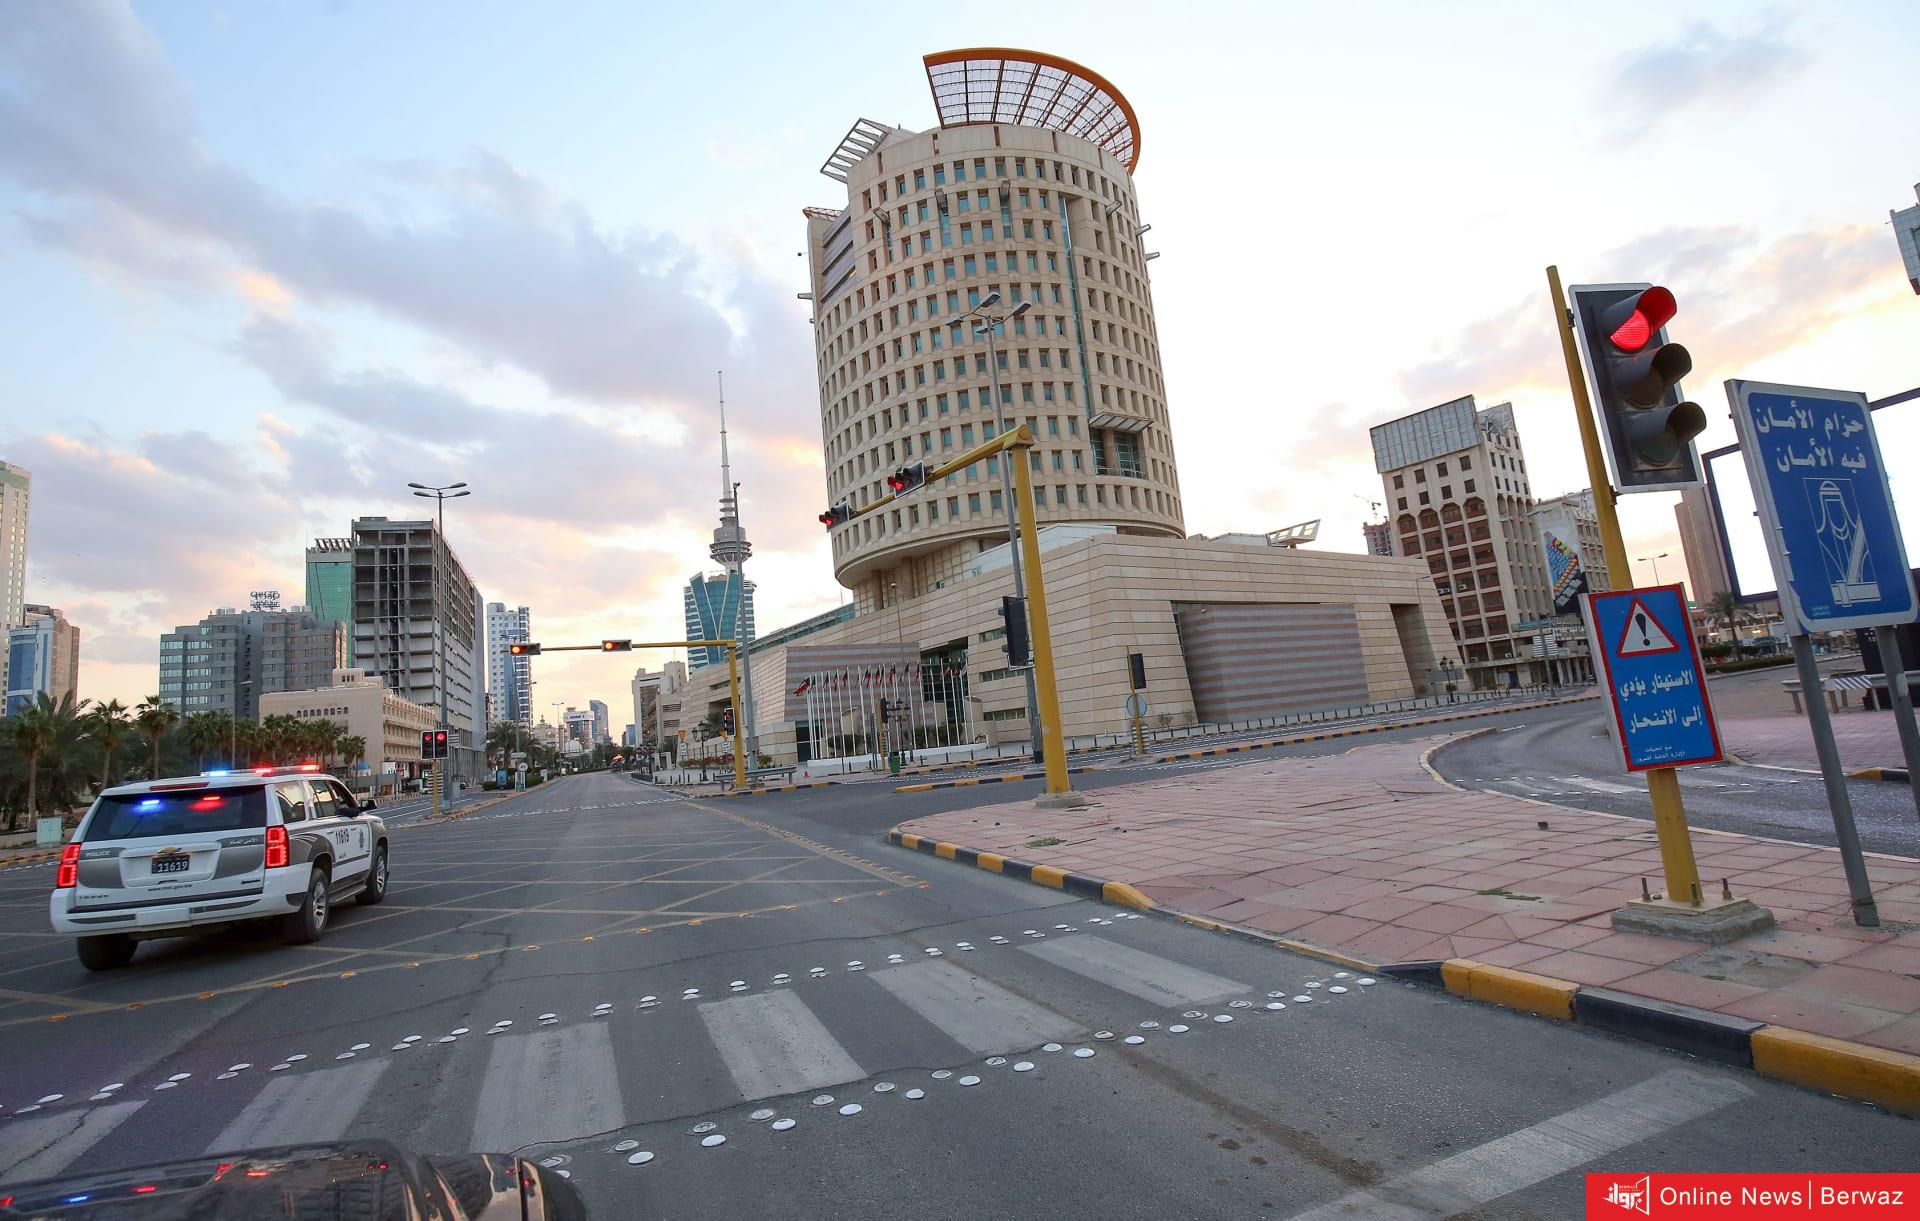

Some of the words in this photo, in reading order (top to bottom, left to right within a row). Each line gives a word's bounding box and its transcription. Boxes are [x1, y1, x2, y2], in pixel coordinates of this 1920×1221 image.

[1756, 400, 1814, 433] الأمان
[1824, 411, 1864, 441] حزام
[1776, 438, 1834, 472] الأمان
[1841, 446, 1866, 474] فيه
[1620, 676, 1647, 702] يؤدي
[1651, 670, 1694, 694] الاستهتار
[1630, 708, 1677, 734] الانتحار
[1682, 705, 1703, 727] إلى
[335, 826, 349, 845] 11619
[85, 850, 110, 858] POLICE
[157, 860, 188, 873] 11619
